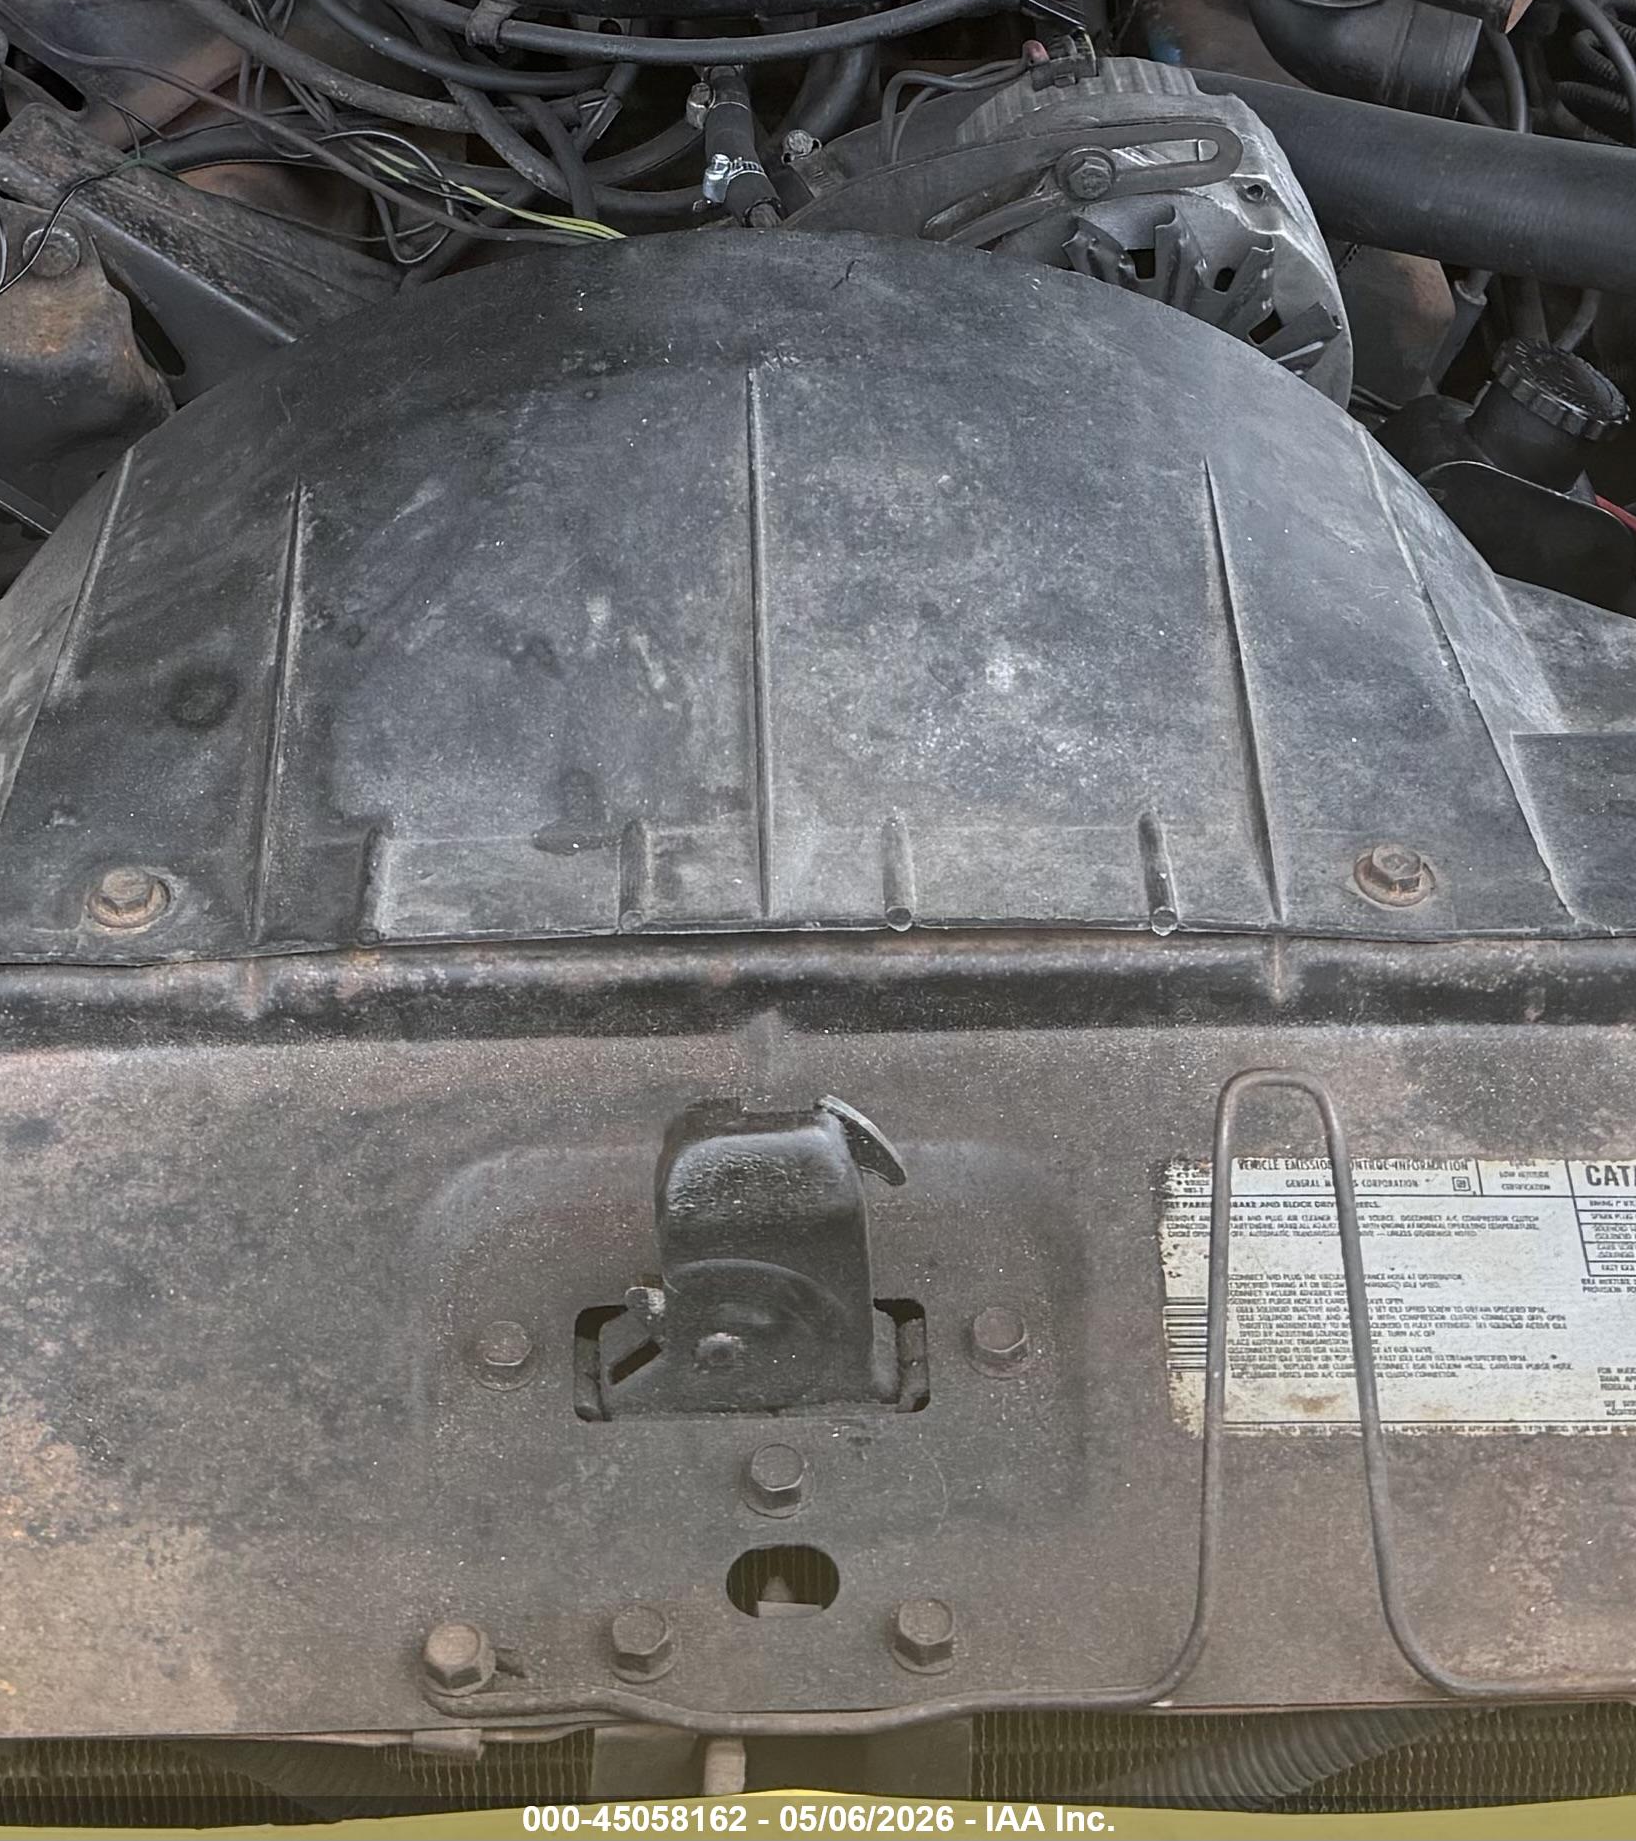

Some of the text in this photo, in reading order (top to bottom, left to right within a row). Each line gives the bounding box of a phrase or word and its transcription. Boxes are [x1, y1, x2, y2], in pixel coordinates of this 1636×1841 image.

[1237, 1158, 1280, 1171] VEHICLE
[1284, 1158, 1333, 1171] EMISSIO
[1285, 1178, 1321, 1188] GENERAL
[1361, 1178, 1420, 1189] CORPORATION
[1259, 1201, 1280, 1209] AND
[1282, 1201, 1312, 1209] BLOCK
